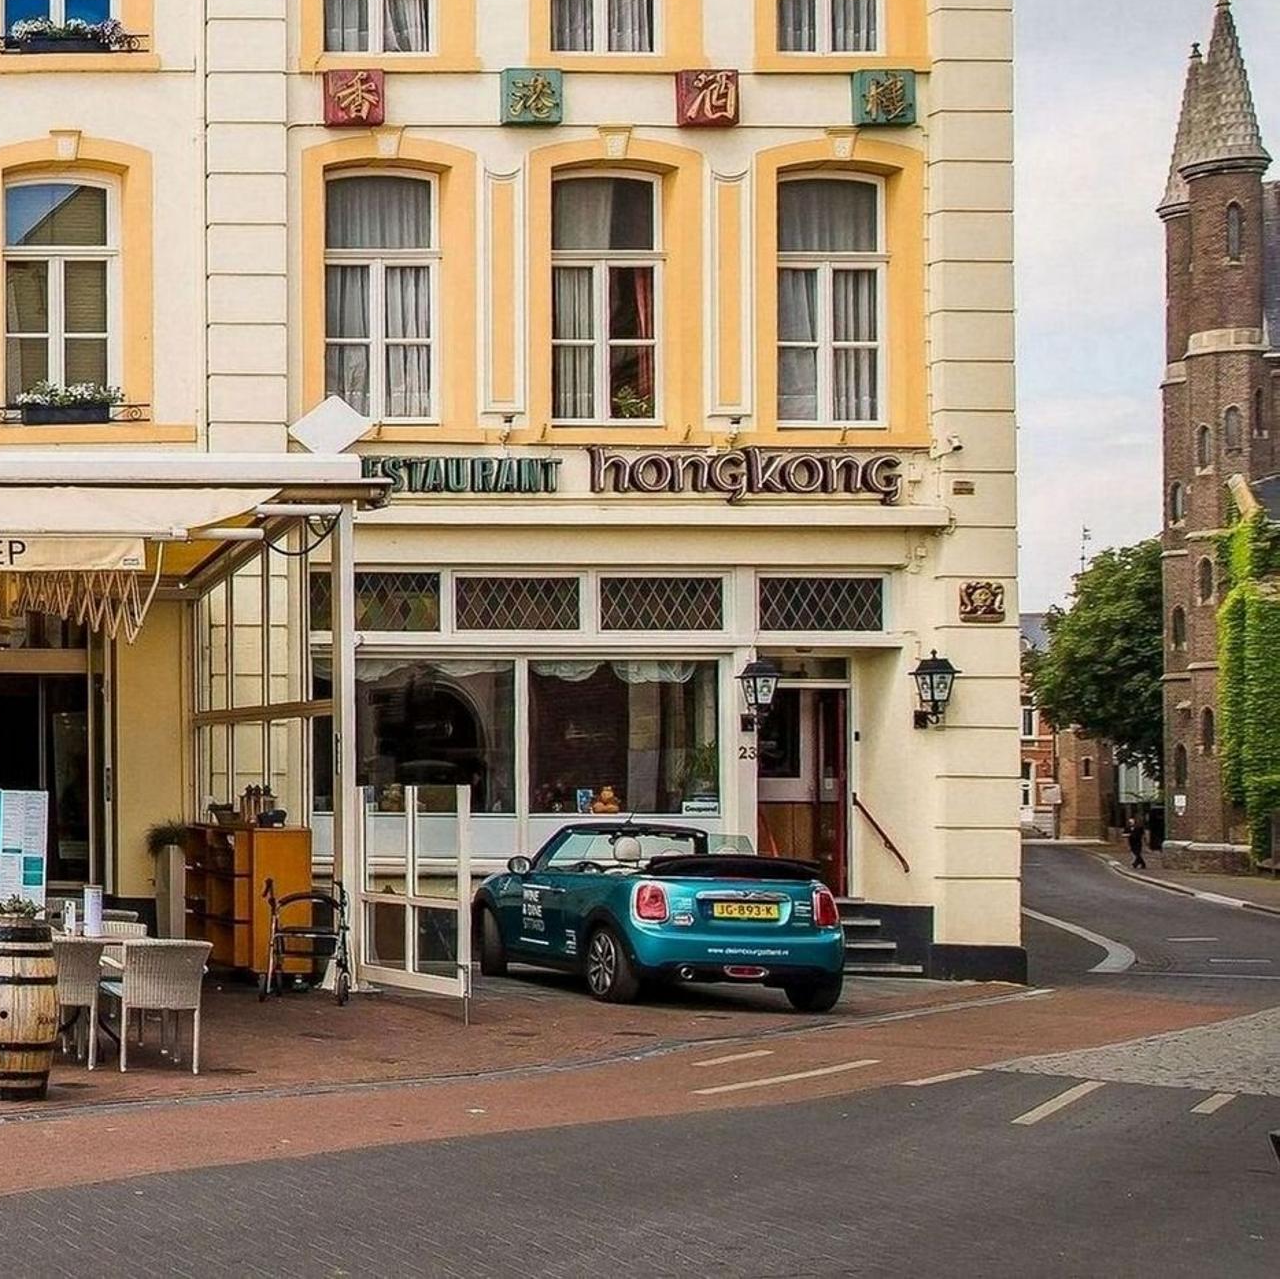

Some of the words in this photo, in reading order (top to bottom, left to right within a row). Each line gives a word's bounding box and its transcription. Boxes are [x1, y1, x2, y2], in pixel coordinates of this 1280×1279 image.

[362, 456, 563, 493] ESTAURANT
[588, 446, 902, 506] hongkong
[738, 745, 757, 760] 23
[718, 903, 774, 917] JG-893-K
